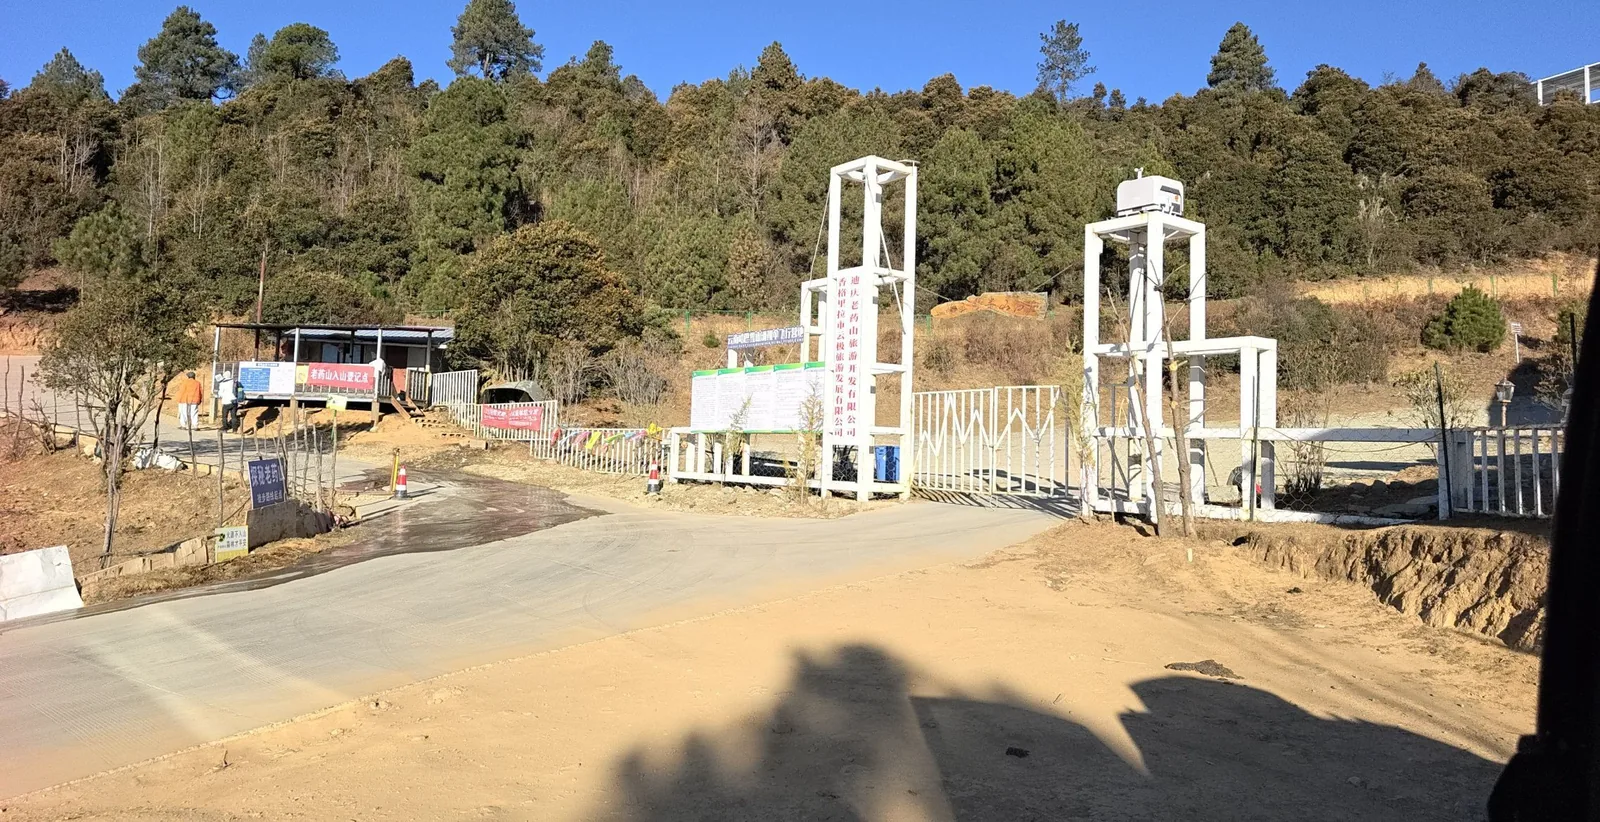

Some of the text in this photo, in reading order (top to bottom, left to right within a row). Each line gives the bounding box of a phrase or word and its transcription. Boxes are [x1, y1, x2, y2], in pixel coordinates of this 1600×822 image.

[310, 368, 369, 383] 老药山入山登记点
[834, 277, 847, 437] 香格里拉市云极旅游发展有限公司
[847, 275, 860, 437] 迪庆老药山旅游开发有限公司
